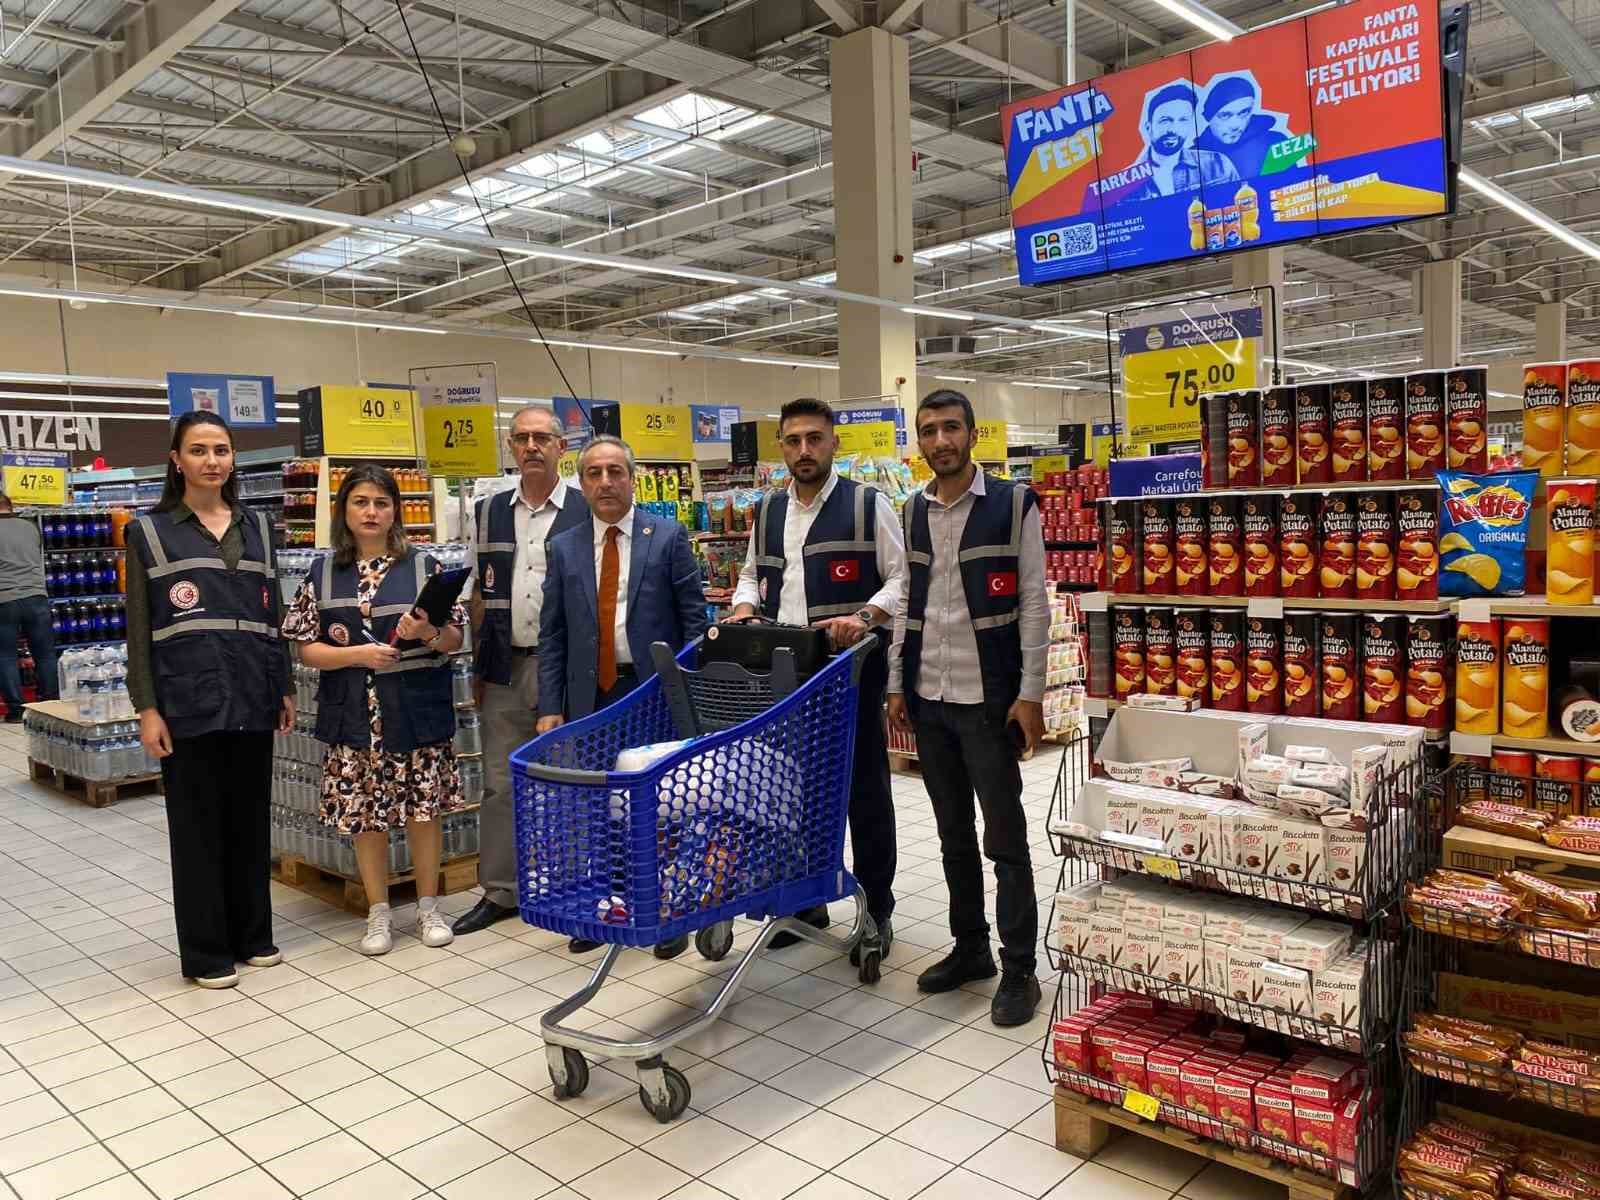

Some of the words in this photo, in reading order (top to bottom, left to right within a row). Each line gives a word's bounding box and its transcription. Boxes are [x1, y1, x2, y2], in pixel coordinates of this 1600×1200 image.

[1363, 4, 1418, 30] FANTA
[1325, 21, 1419, 58] KAPAKLARI
[1306, 41, 1420, 88] FESTİVALE
[1316, 63, 1420, 105] AÇILIYOR!
[1016, 88, 1113, 142] FANTA
[1036, 122, 1104, 173] FEST
[1271, 134, 1317, 159] CEZA
[1089, 162, 1154, 196] TARKAN
[1172, 312, 1233, 335] DOĞRUSU
[1525, 394, 1560, 409] Potato
[1141, 479, 1180, 497] Markalı
[1401, 510, 1432, 519] Master
[1444, 495, 1531, 526] Ruffles
[1556, 506, 1591, 517] Master
[1357, 520, 1390, 533] Potato
[1399, 519, 1434, 532] Potato
[1552, 517, 1593, 531] Potato
[1176, 638, 1205, 649] Potato
[1411, 639, 1440, 649] Master
[1460, 641, 1492, 652] Master
[1512, 643, 1544, 654] Master
[1408, 647, 1443, 659] Potato
[1457, 649, 1495, 663] Potato
[1507, 652, 1546, 665] Potato
[1243, 824, 1279, 833] Biscolata
[1282, 831, 1319, 841] Biscolata
[1315, 979, 1356, 991] Biscolata
